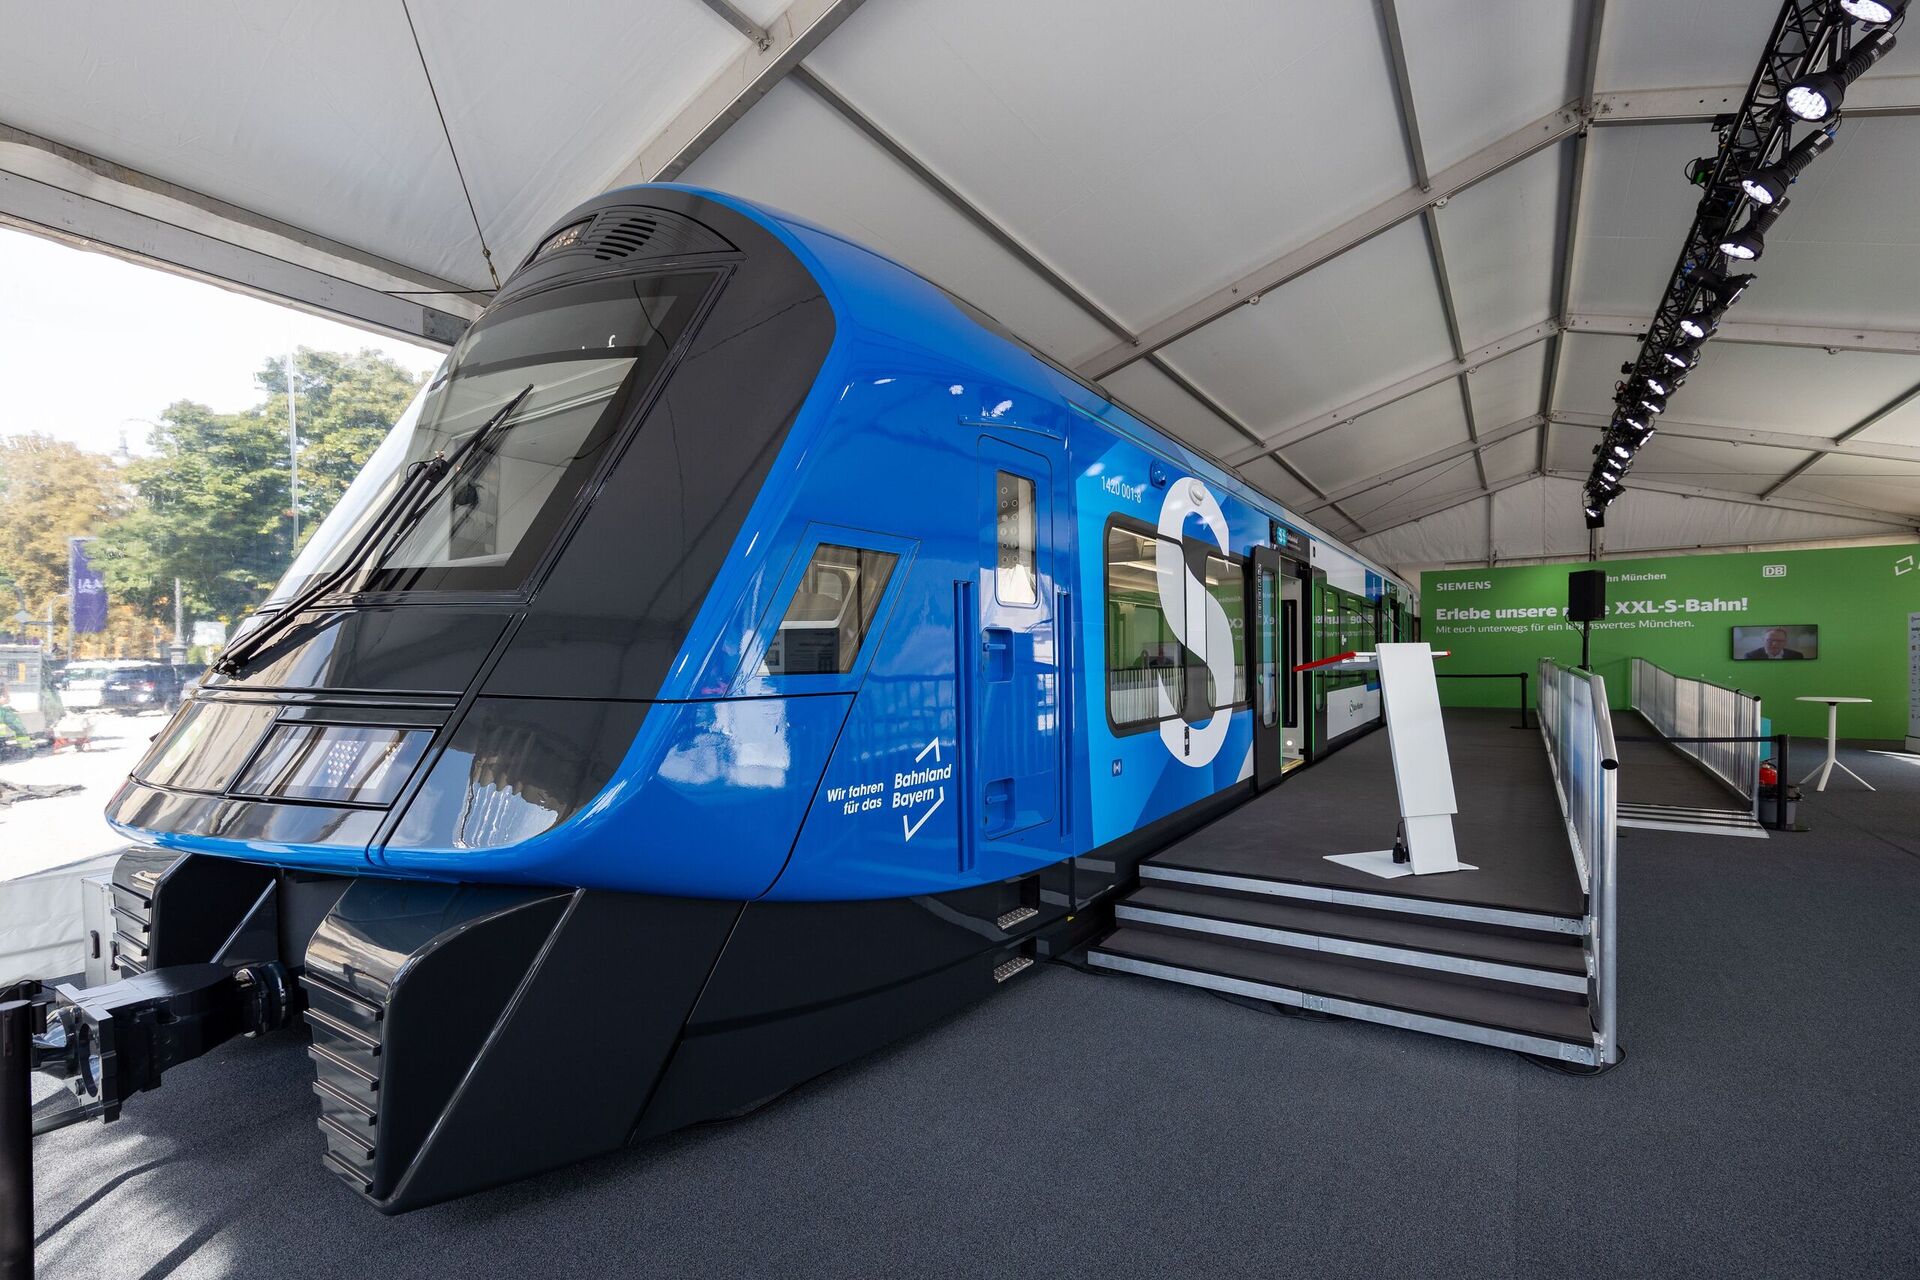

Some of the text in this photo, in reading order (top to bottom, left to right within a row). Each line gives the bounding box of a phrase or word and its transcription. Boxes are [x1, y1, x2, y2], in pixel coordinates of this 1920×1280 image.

[1101, 476, 1142, 504] 1420 001-8
[1621, 572, 1667, 582] München
[1765, 567, 1785, 576] DB
[1436, 580, 1491, 591] SIEMENS
[1436, 607, 1490, 620] Erlebe
[1495, 606, 1557, 619] unsere
[1615, 597, 1749, 615] XXL-S-Bahn!
[1156, 477, 1235, 767] S
[1436, 625, 1451, 634] Mit
[1453, 624, 1476, 634] euch
[1478, 624, 1528, 634] unterwegs
[1530, 622, 1545, 632] für
[1547, 622, 1563, 631] ein
[1638, 618, 1695, 629] München.
[894, 764, 952, 789] Bahnland
[827, 782, 884, 802] Wir fahren
[892, 788, 934, 809] Bayern
[843, 797, 882, 815] für das
